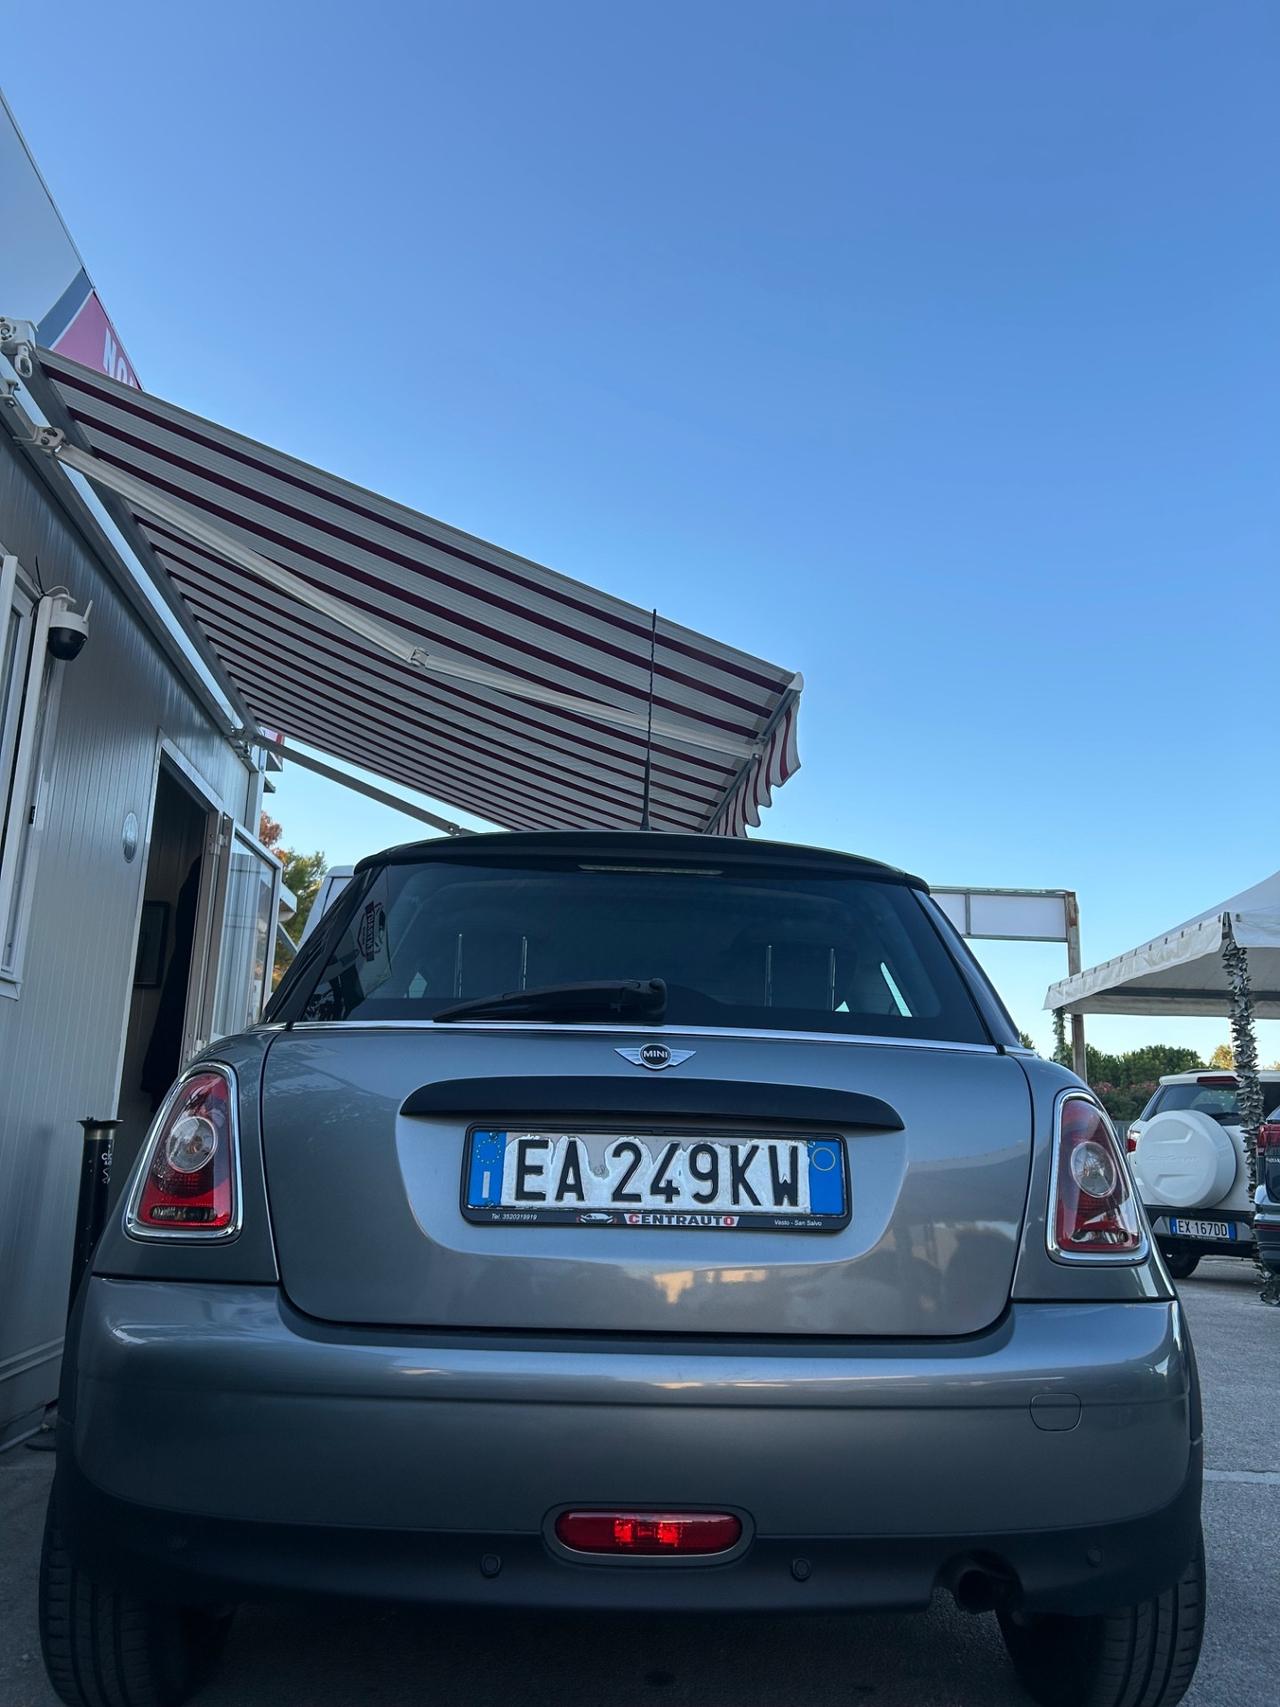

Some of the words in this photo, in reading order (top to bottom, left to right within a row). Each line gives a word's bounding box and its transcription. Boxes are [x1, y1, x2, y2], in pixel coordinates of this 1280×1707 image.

[643, 1050, 668, 1058] MINI
[628, 1214, 736, 1227] CENTRAUTO
[806, 1219, 823, 1227] Salvo
[1178, 1220, 1192, 1234] EX
